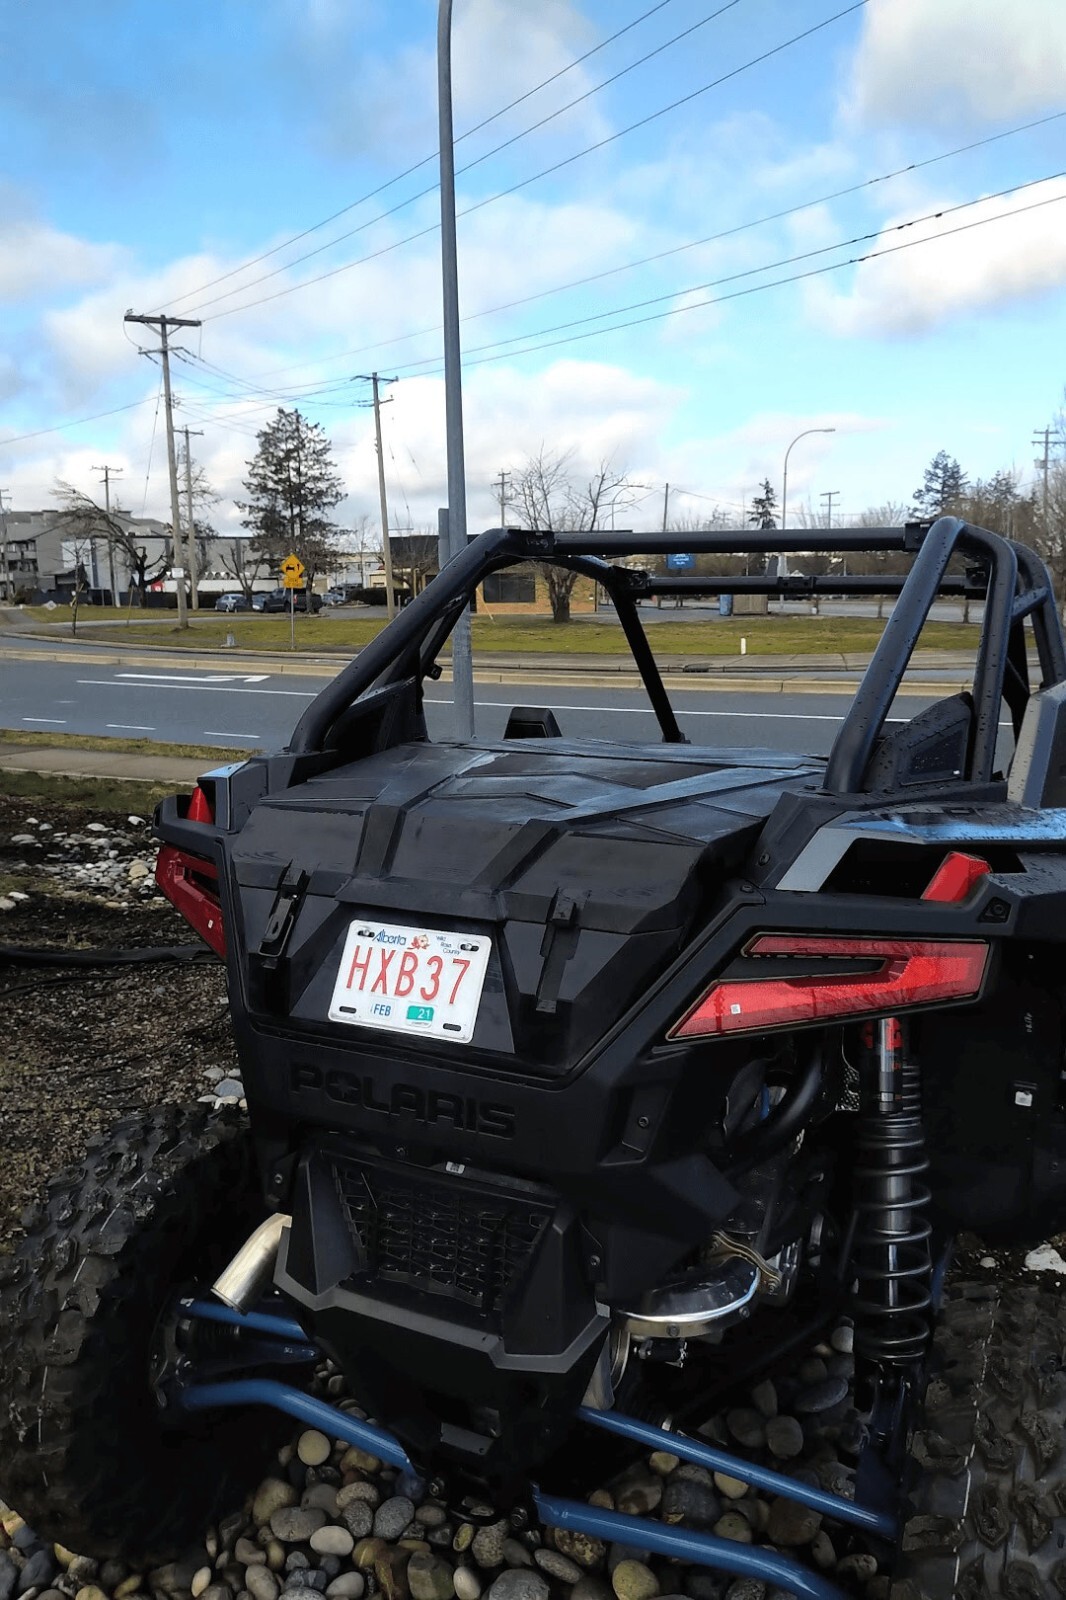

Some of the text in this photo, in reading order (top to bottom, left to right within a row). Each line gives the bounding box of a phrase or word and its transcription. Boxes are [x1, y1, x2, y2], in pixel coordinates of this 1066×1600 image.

[372, 929, 407, 946] Alberta
[346, 945, 471, 1005] HXB37
[373, 1003, 391, 1016] FEB
[417, 1008, 431, 1019] 21
[289, 1061, 516, 1141] POLARIS
